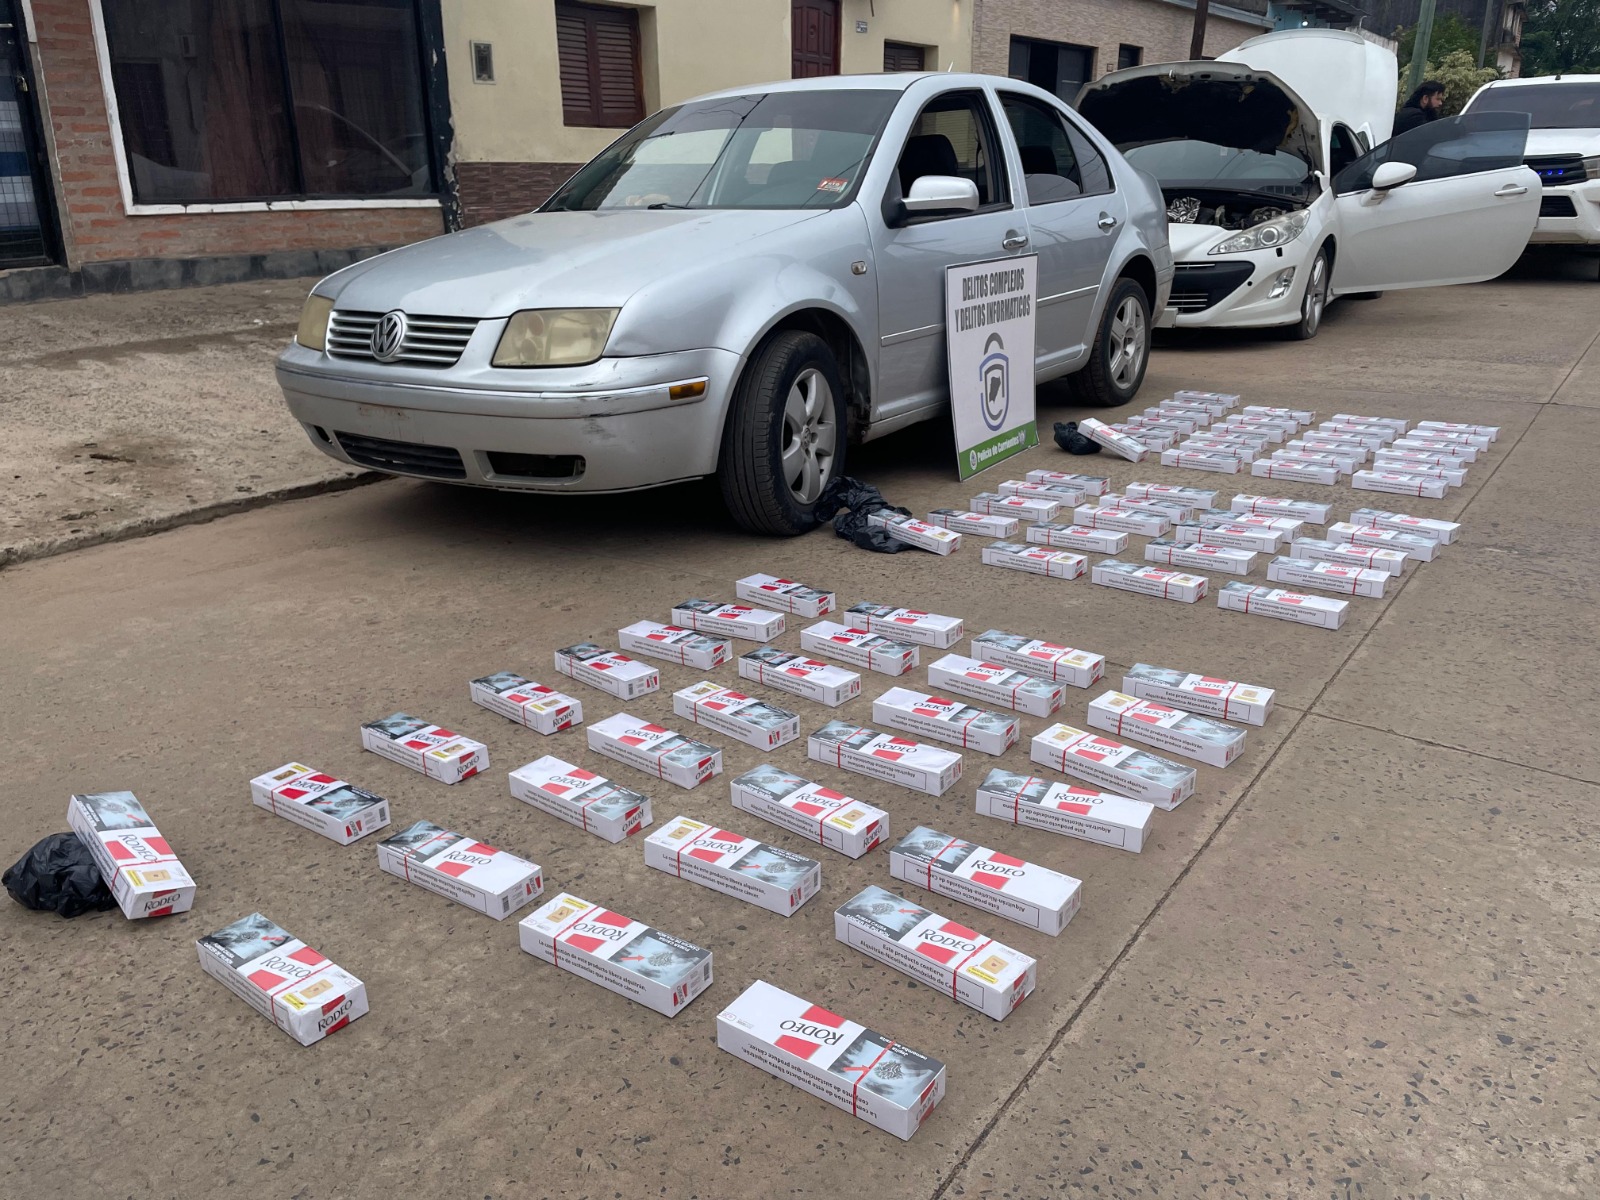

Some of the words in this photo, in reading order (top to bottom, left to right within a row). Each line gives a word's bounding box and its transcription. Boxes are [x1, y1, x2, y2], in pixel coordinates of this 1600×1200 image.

[962, 274, 988, 301] DELITOS
[990, 268, 1024, 297] COMPLEJOS
[955, 308, 960, 332] Y
[960, 305, 986, 332] DELITOS
[987, 294, 1030, 325] INFORMATICOS
[1002, 803, 1024, 812] Caono
[1054, 793, 1104, 805] RODEO
[864, 824, 882, 848] RODEO
[118, 835, 158, 863] RODEO
[694, 840, 743, 853] RODEO
[444, 851, 491, 865] RODEO
[916, 868, 938, 880] Carono
[971, 860, 1025, 877] RODEO
[938, 884, 961, 896] contiene
[962, 891, 987, 905] producto
[144, 894, 180, 911] RODEO
[987, 901, 999, 910] Este
[574, 923, 628, 941] RODEO
[918, 929, 976, 951] RODEO
[544, 941, 569, 957] comustión
[544, 948, 564, 962] conjnto
[260, 956, 311, 978] RODEO
[882, 943, 893, 953] Este
[894, 949, 918, 966] producto
[919, 961, 943, 978] contiene
[936, 977, 944, 985] de
[944, 981, 969, 998] Carono
[318, 1000, 352, 1032] RODEO
[780, 1020, 844, 1045] RODEO
[767, 1051, 790, 1068] produce
[768, 1060, 784, 1073] libera
[790, 1062, 802, 1073] que
[786, 1068, 811, 1086] producto
[802, 1070, 832, 1089] sustancias
[812, 1082, 824, 1092] este
[825, 1088, 833, 1097] de
[833, 1084, 841, 1093] de
[833, 1092, 868, 1114] comustión
[841, 1087, 868, 1107] conjnto
[869, 1110, 876, 1118] La
